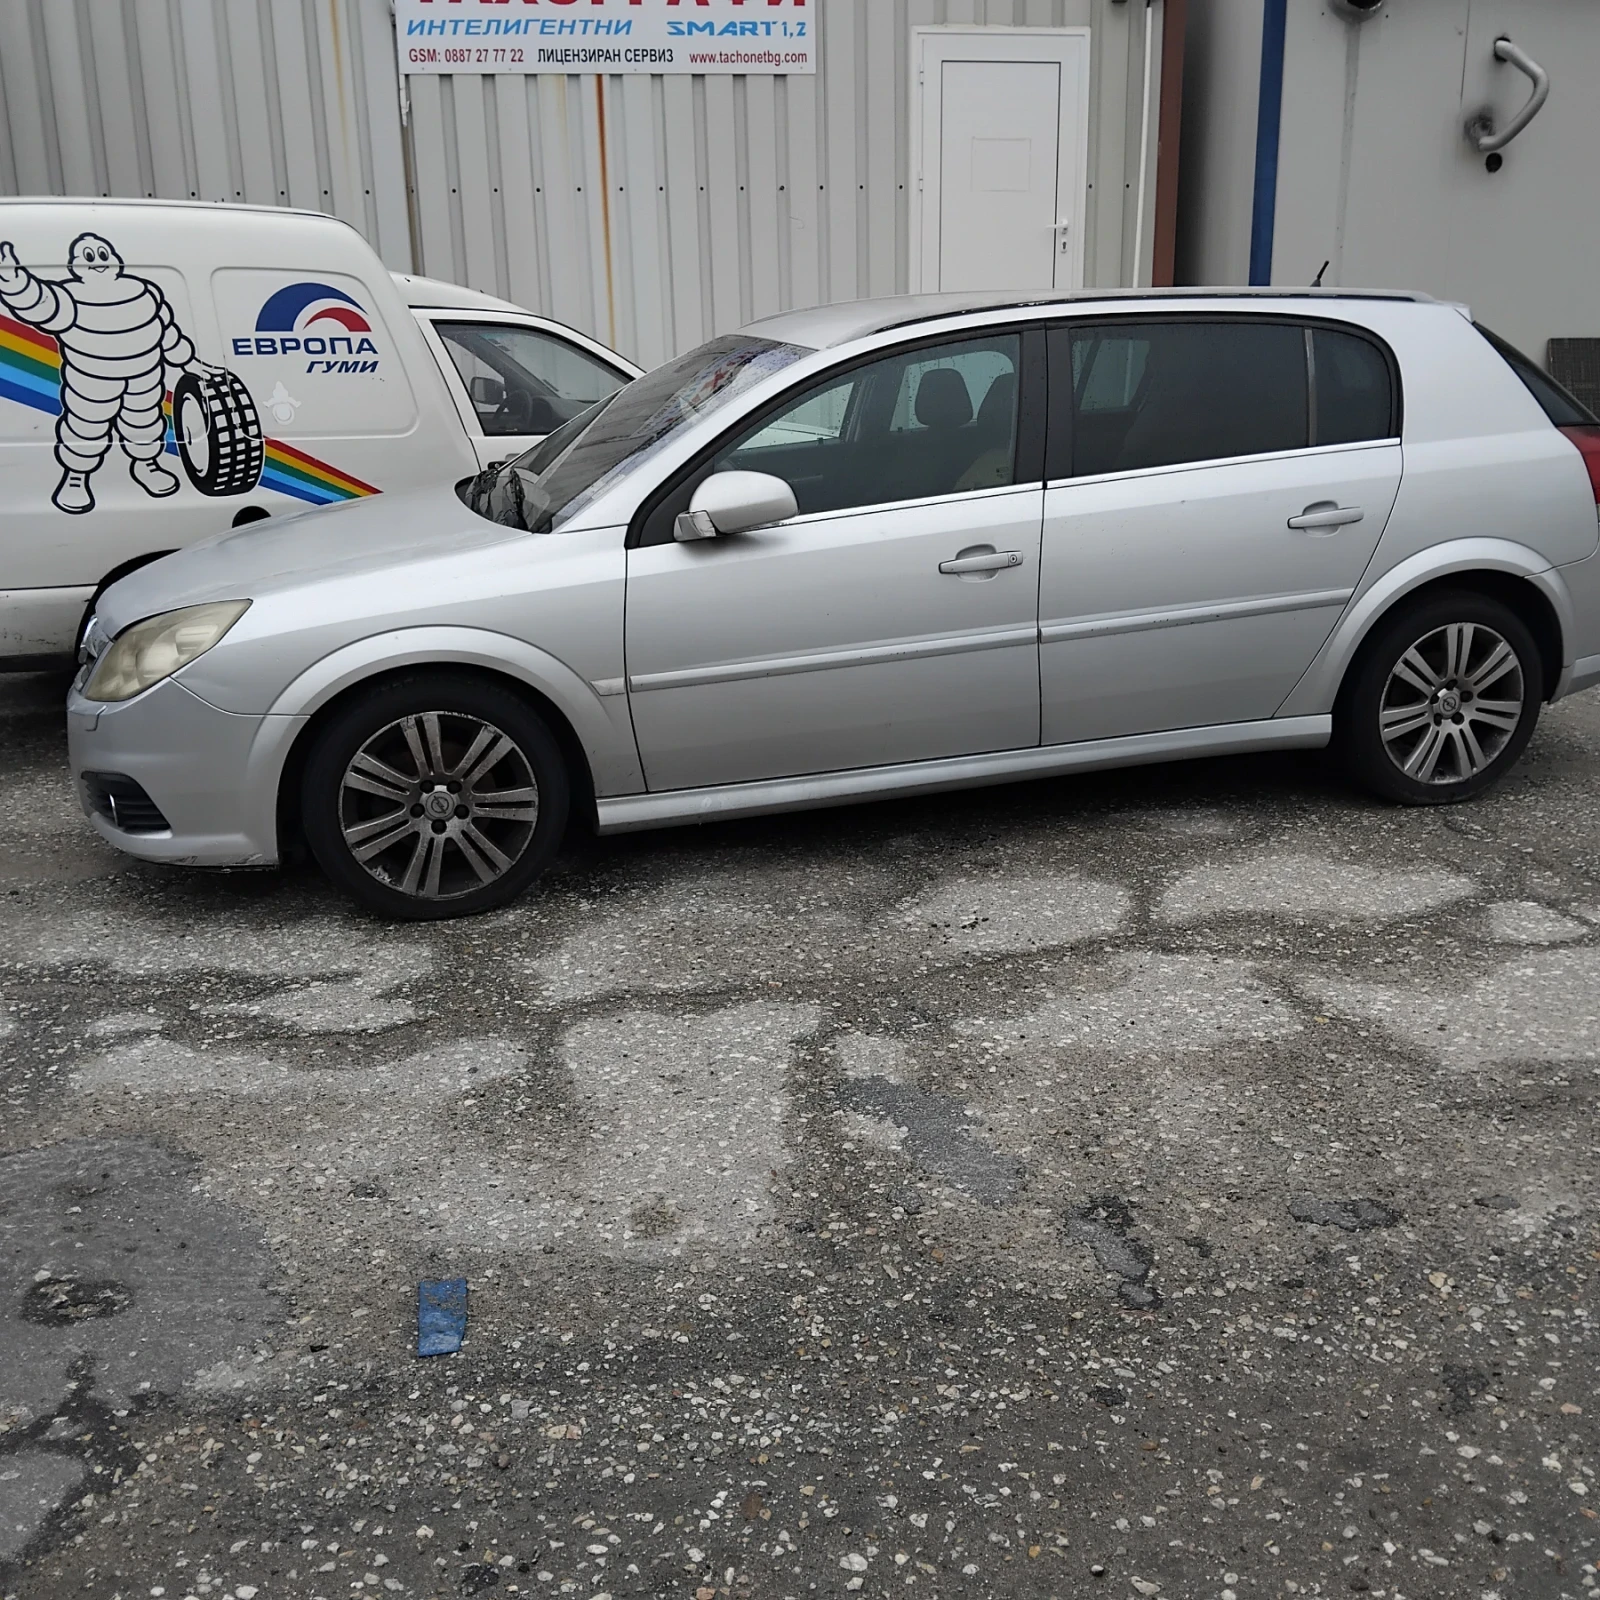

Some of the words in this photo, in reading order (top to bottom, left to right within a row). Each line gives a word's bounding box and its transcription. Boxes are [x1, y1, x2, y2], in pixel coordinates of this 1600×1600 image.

[407, 19, 633, 36] ИНТЕЛИГЕНТНИ
[666, 20, 779, 37] SMART
[781, 21, 807, 39] 1,2
[408, 48, 441, 63] GSM:
[444, 48, 472, 63] 0887
[476, 48, 489, 63] 27
[493, 48, 507, 63] 77
[510, 48, 524, 63] 22
[537, 48, 622, 65] ЛИЦЕНЗИРАН
[624, 48, 674, 63] СЕРВИЗ
[689, 50, 808, 66] www.tachonetbg.com
[231, 337, 379, 356] ЕВРОПА
[306, 360, 380, 374] ГУМИ
